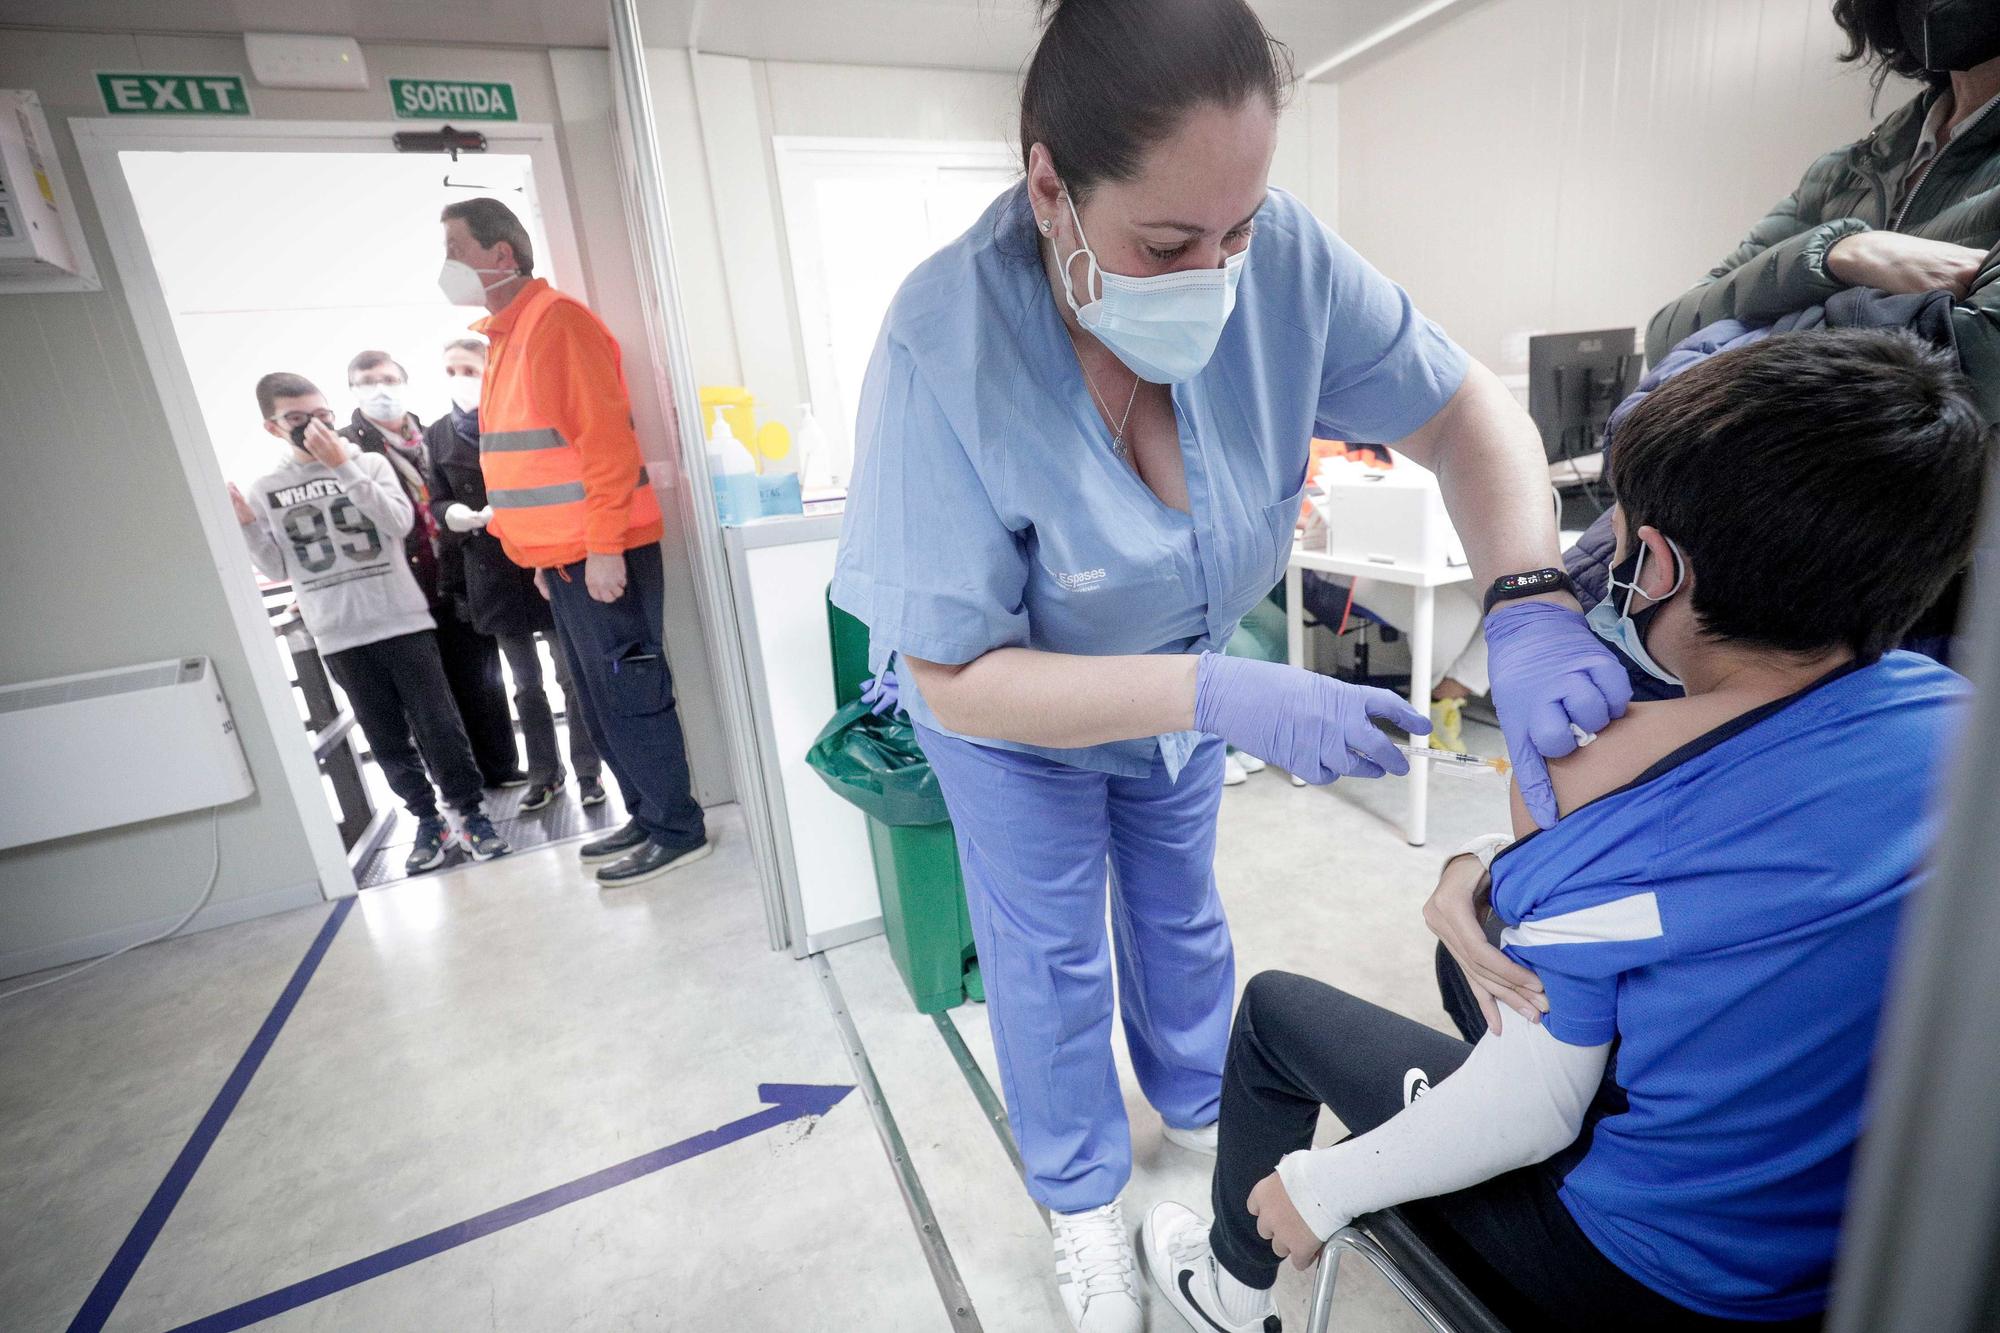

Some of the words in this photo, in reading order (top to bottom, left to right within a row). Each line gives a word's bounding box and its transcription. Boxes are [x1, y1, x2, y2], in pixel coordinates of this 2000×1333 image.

[109, 79, 236, 111] EXIT
[400, 83, 508, 113] SORTIDA
[1058, 568, 1107, 589] Espases
